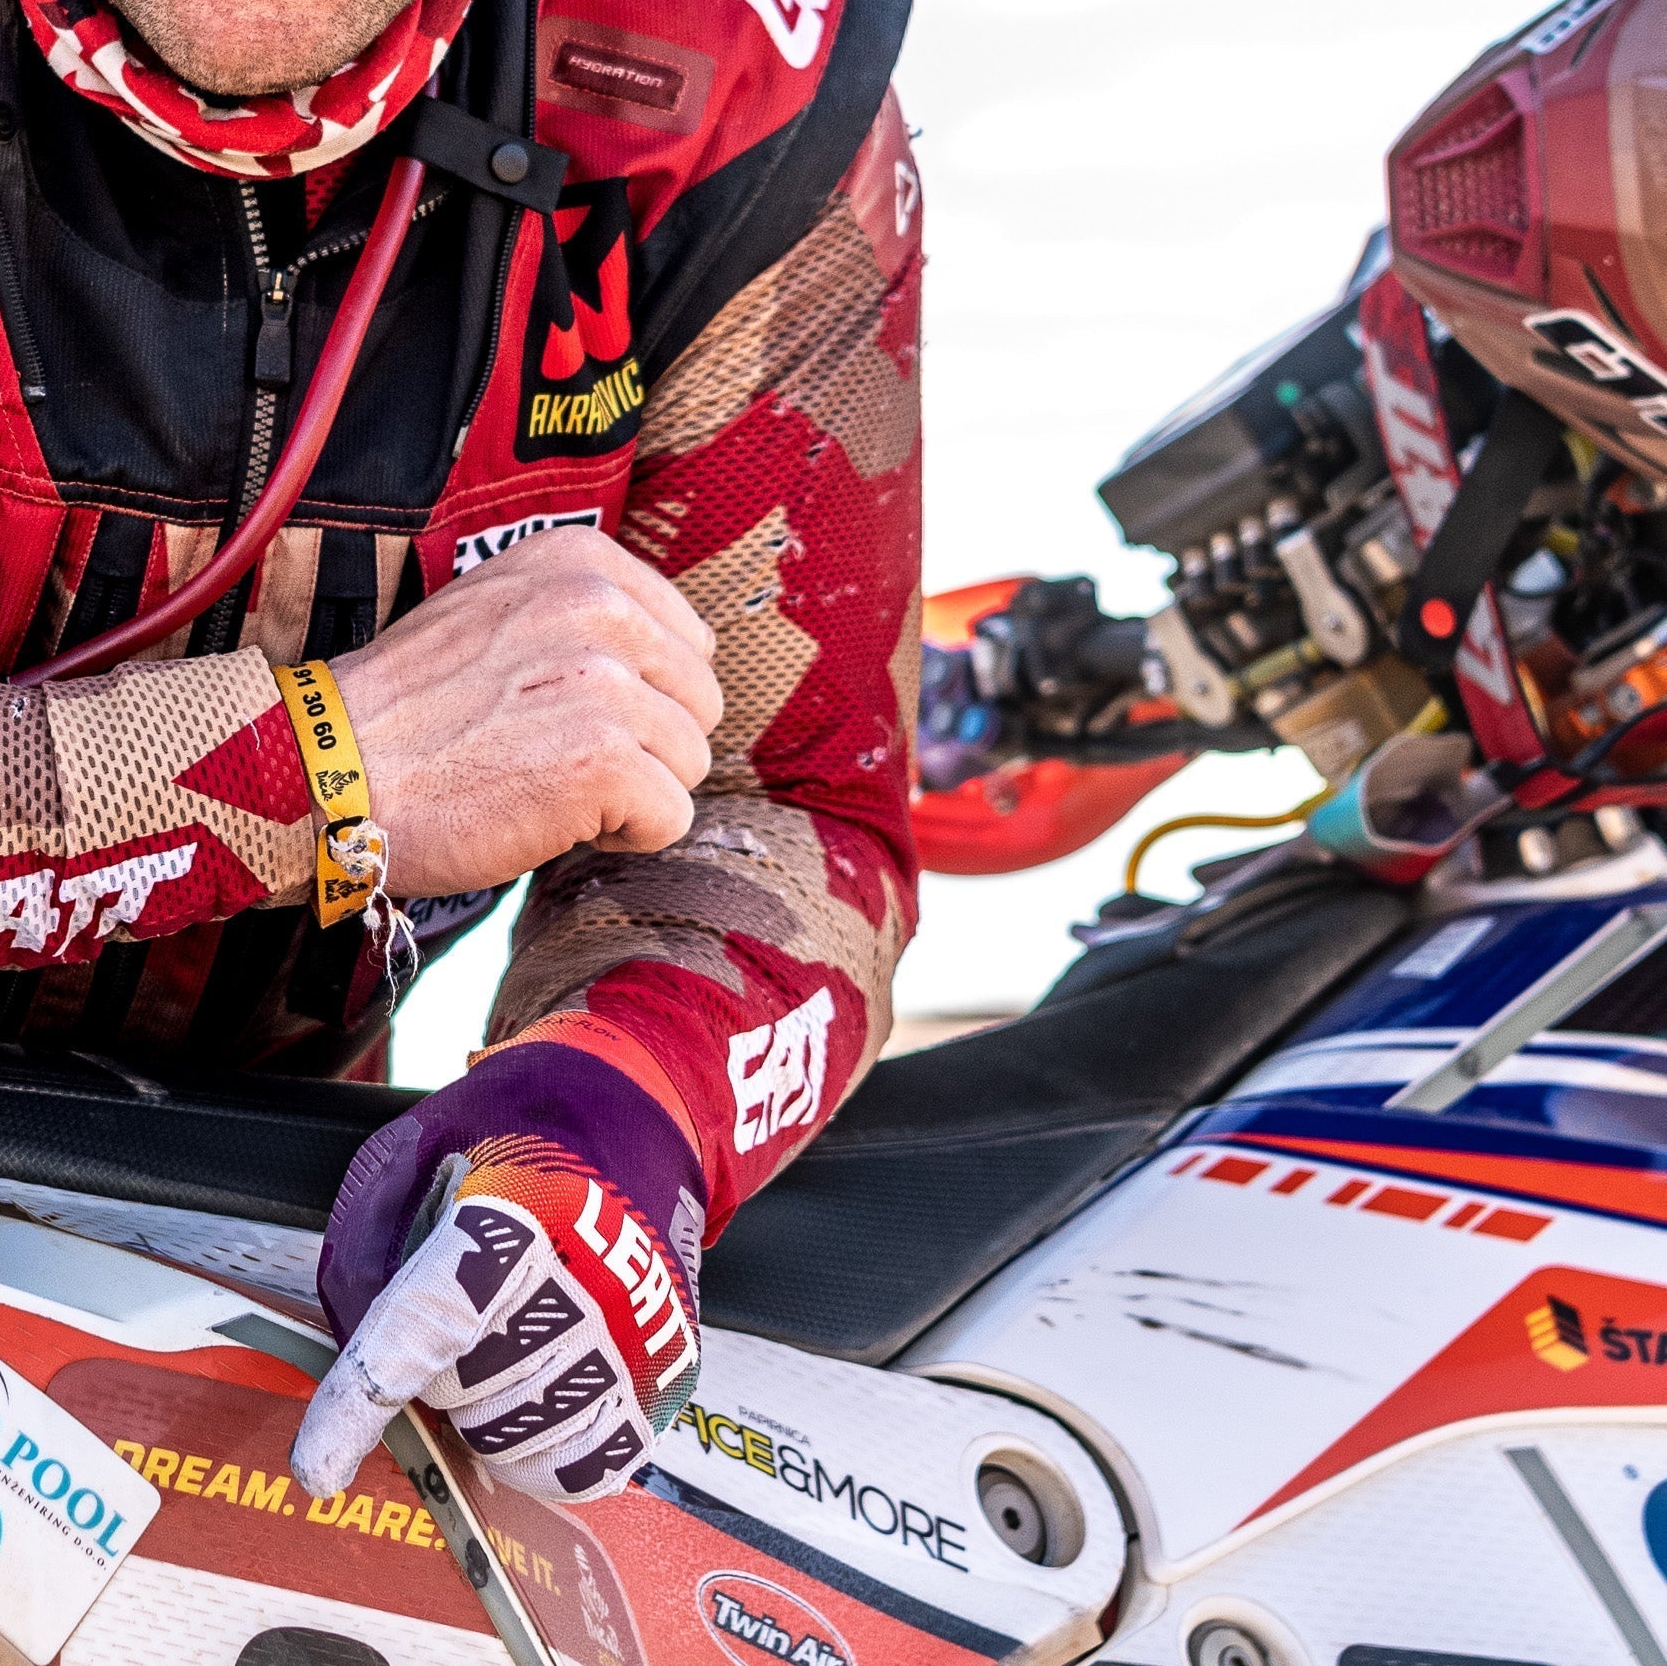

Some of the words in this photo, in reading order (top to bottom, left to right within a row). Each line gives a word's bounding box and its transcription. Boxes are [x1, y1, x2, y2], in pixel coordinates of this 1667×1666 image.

[568, 55, 663, 88] HYDRATION
[303, 691, 327, 718] 30
[313, 721, 337, 751] 60
[573, 1178, 699, 1392] LEATT
[0, 1430, 128, 1557] POOL
[305, 1490, 446, 1551] DARE.
[73, 1536, 108, 1571] D.O.O.
[712, 1589, 792, 1659] Twin
